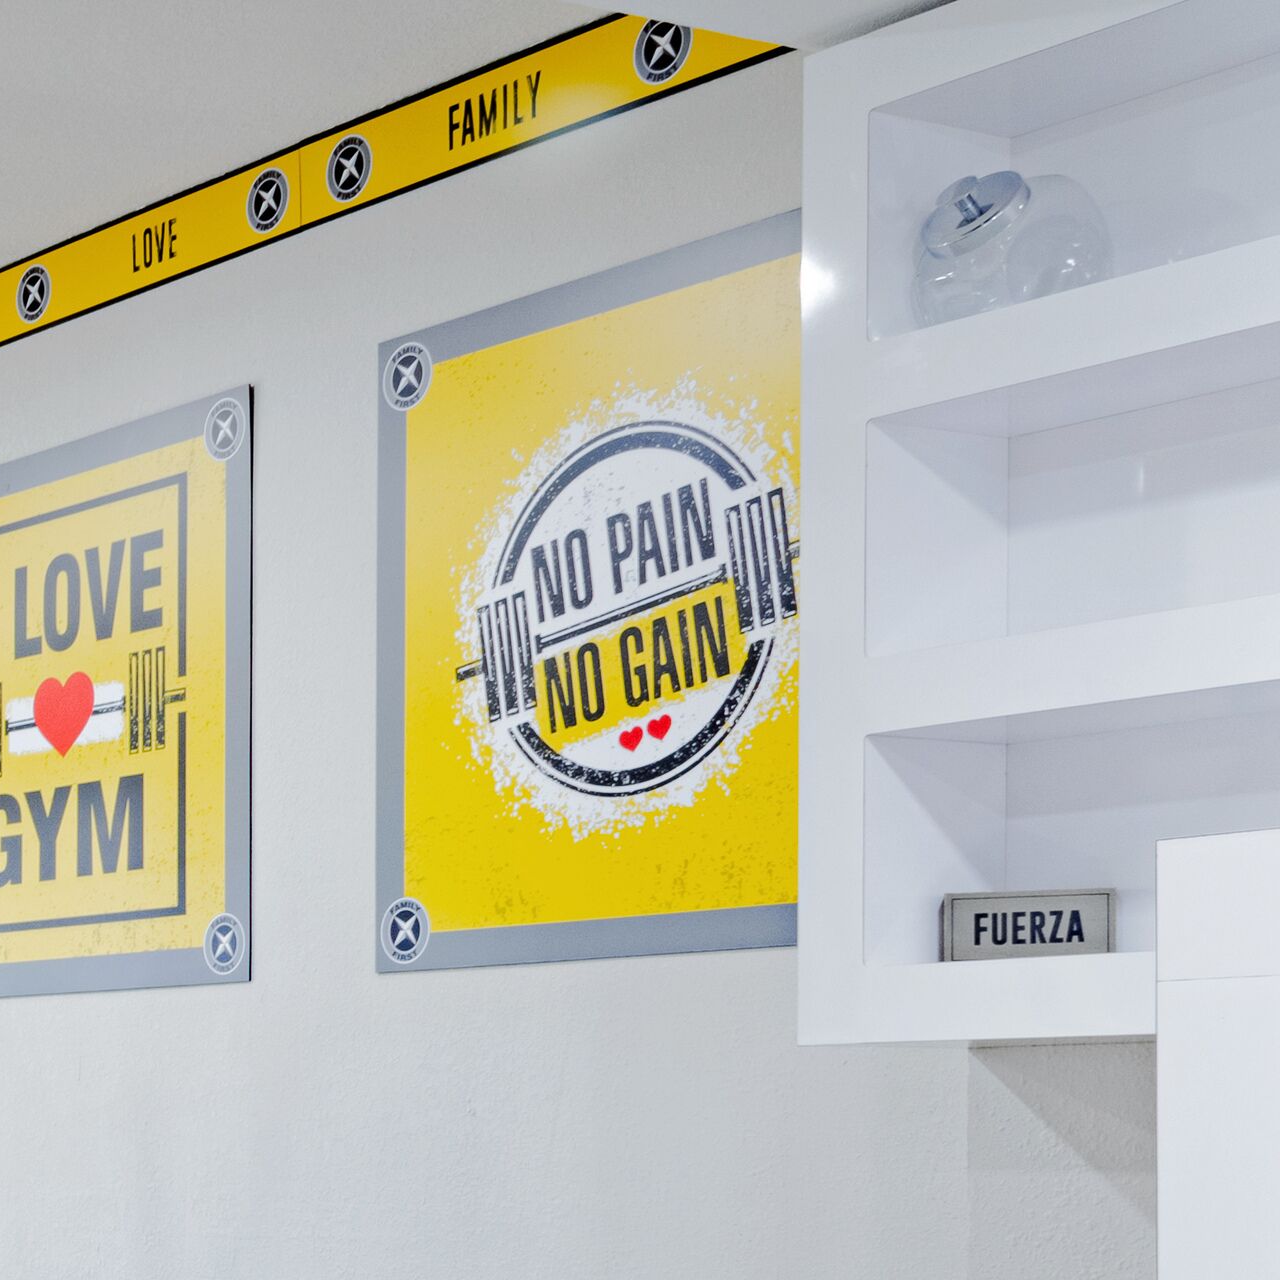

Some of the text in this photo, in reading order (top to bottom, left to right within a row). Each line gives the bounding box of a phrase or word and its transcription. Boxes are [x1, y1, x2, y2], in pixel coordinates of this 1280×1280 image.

[448, 69, 542, 152] FAMILY
[131, 217, 178, 274] LOVE
[391, 345, 424, 364] FAMILY
[394, 392, 421, 408] FIRST
[530, 477, 716, 624] NO PAIN
[13, 528, 164, 661] LOVE
[543, 595, 731, 734] NO GAIN
[390, 901, 422, 915] FAMILY
[973, 909, 1085, 946] FUERZA
[392, 950, 417, 961] FIRST
